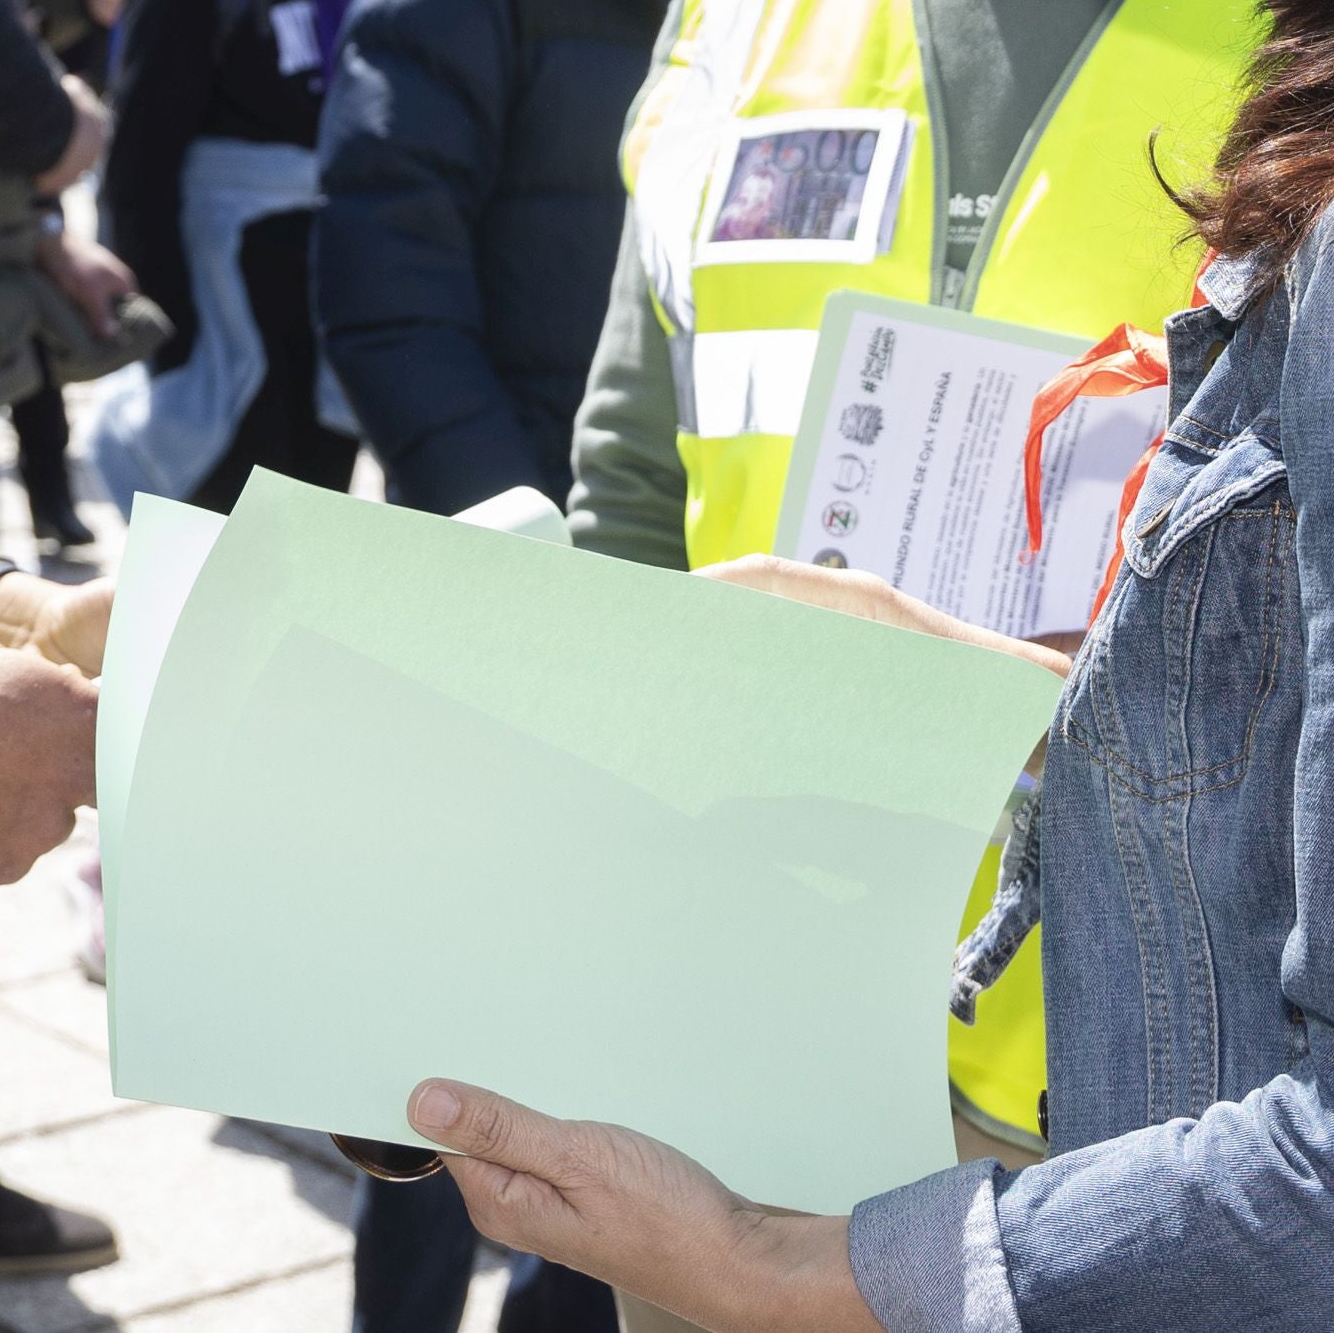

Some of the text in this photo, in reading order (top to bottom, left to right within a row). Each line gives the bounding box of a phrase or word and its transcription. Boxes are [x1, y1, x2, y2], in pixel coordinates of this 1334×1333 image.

[927, 369, 951, 424] ESPAÑA
[924, 424, 937, 435] Y
[912, 463, 927, 484] DE
[901, 484, 922, 532] RURAL
[890, 533, 911, 589] MUNDO
